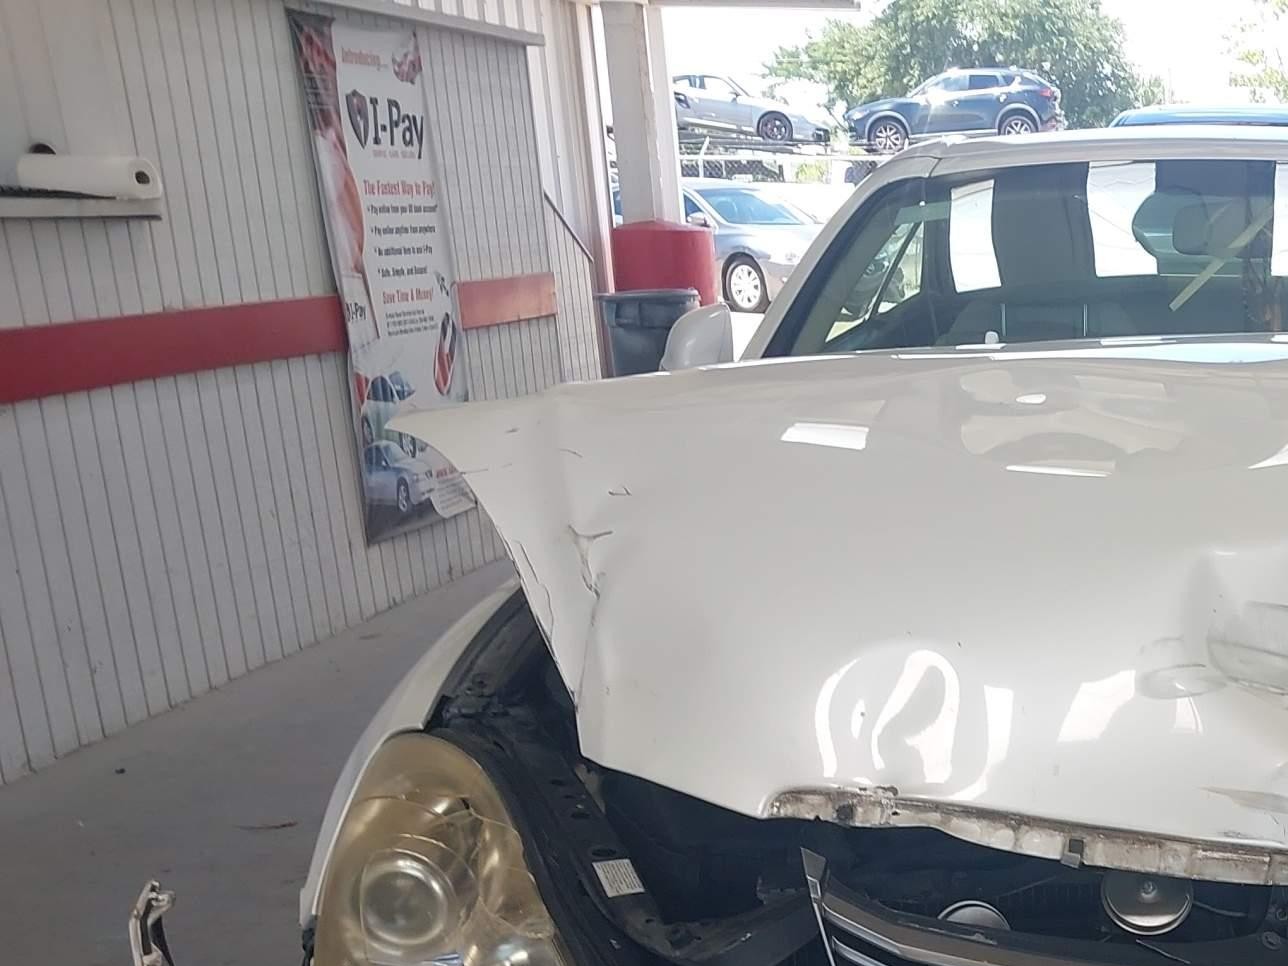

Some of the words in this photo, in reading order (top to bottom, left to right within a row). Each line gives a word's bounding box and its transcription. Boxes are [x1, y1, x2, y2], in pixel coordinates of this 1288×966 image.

[370, 96, 424, 160] I-Pay
[363, 180, 375, 196] The
[377, 180, 400, 196] Fastest
[401, 180, 414, 199] Way
[415, 181, 421, 196] to
[382, 290, 395, 305] Save
[397, 289, 409, 302] Time
